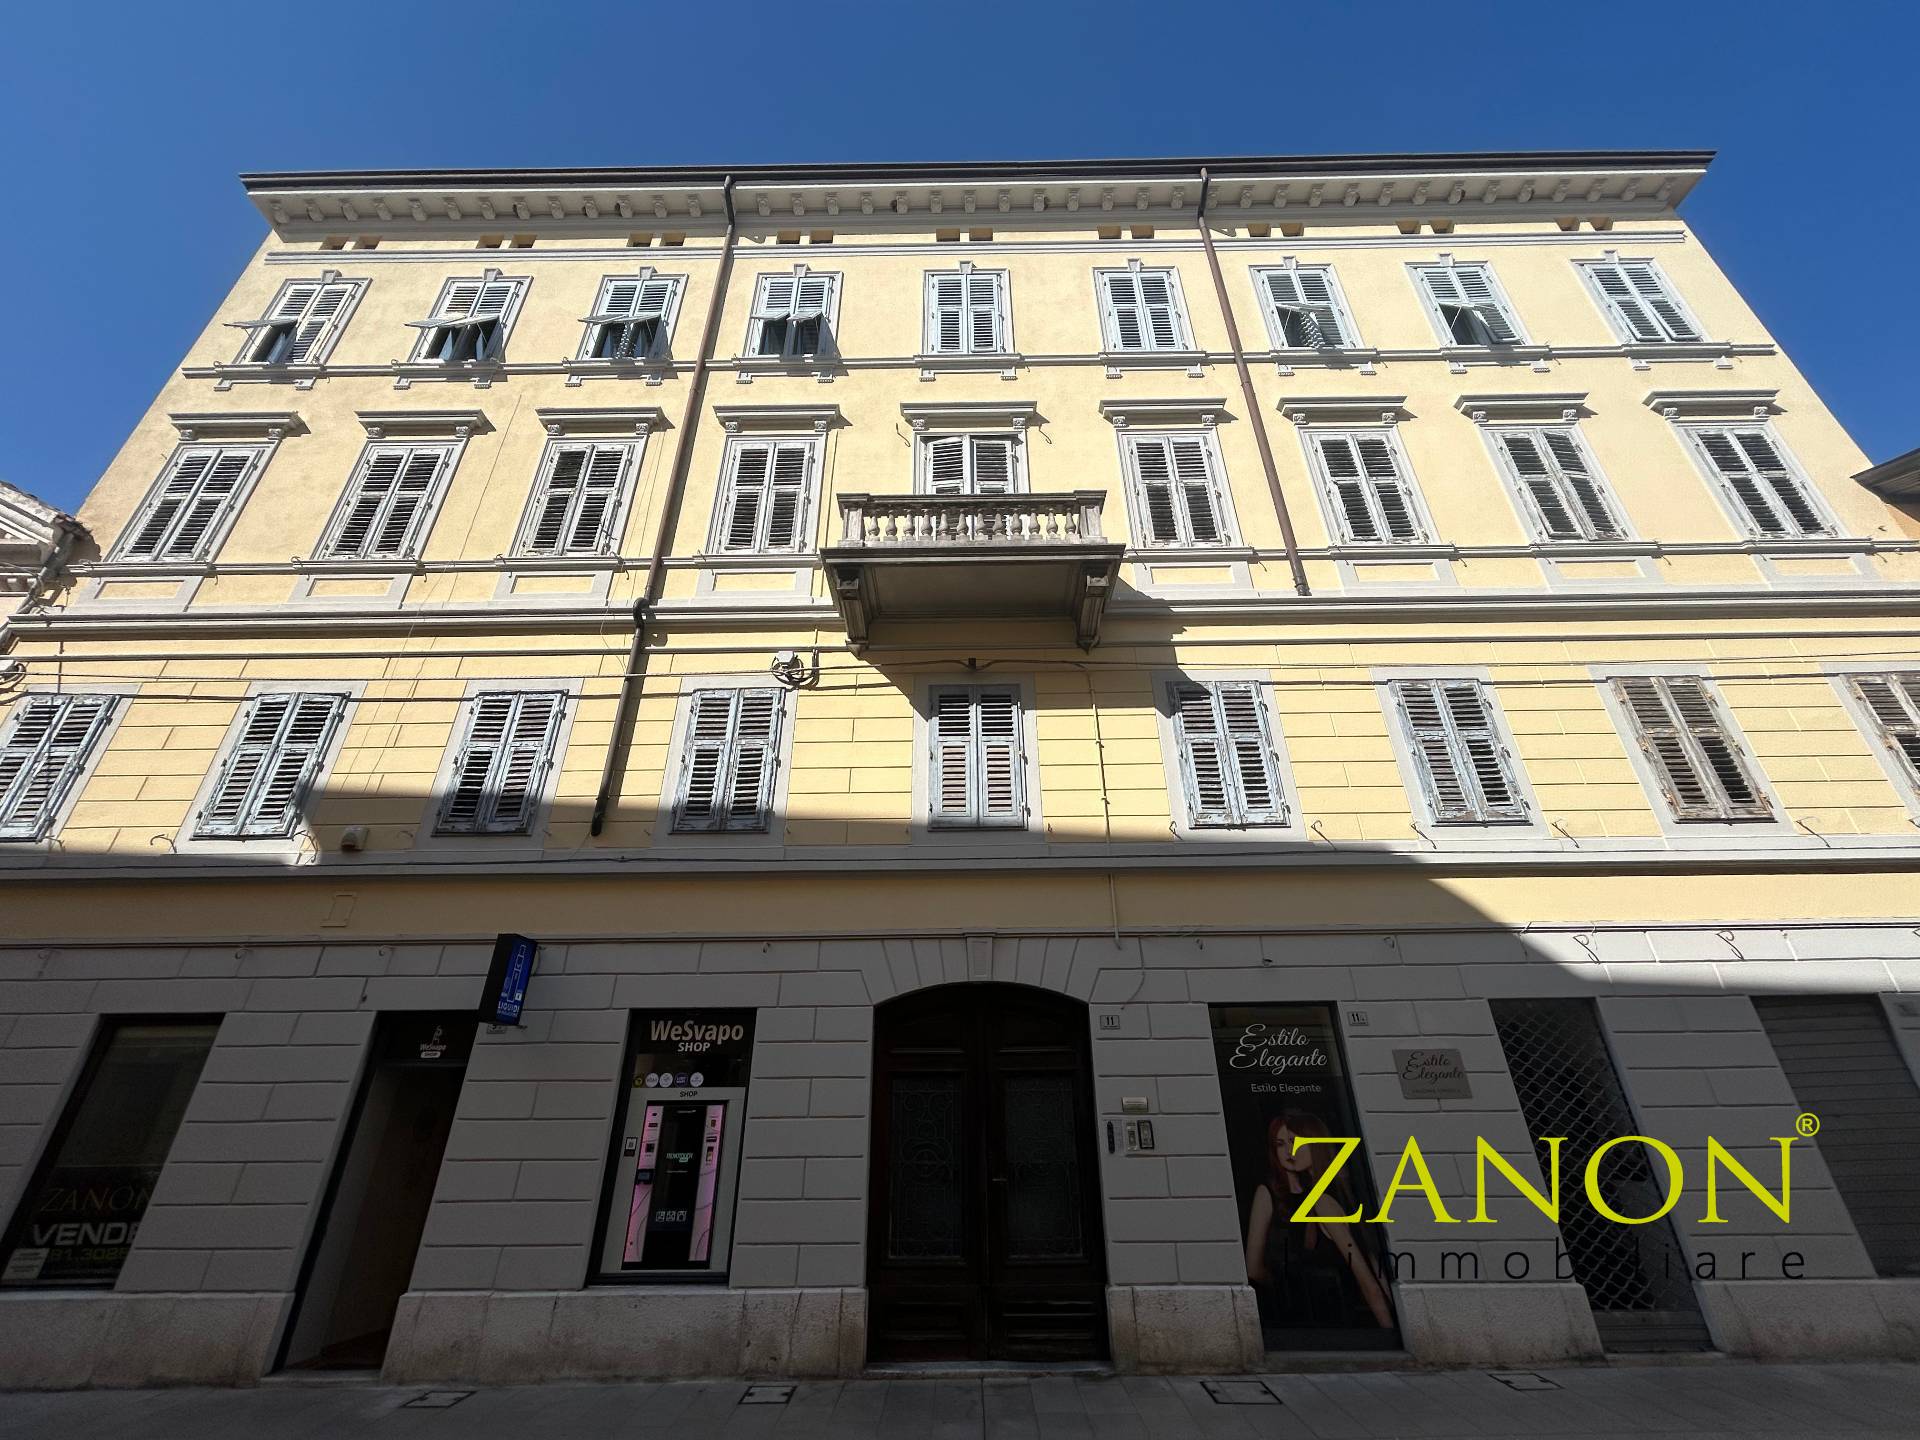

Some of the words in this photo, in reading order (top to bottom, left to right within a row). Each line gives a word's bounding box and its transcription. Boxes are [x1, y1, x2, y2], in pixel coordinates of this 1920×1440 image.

[651, 1020, 744, 1045] WeSvapo
[1240, 1023, 1310, 1047] Estilo
[677, 1042, 711, 1052] SHOP
[1229, 1044, 1328, 1076] Elegante
[1407, 1051, 1449, 1067] Estilo
[1402, 1064, 1464, 1085] Elegante
[679, 1090, 698, 1098] SHOP
[1251, 1083, 1277, 1093] Estilo
[1279, 1083, 1321, 1094] Elegante
